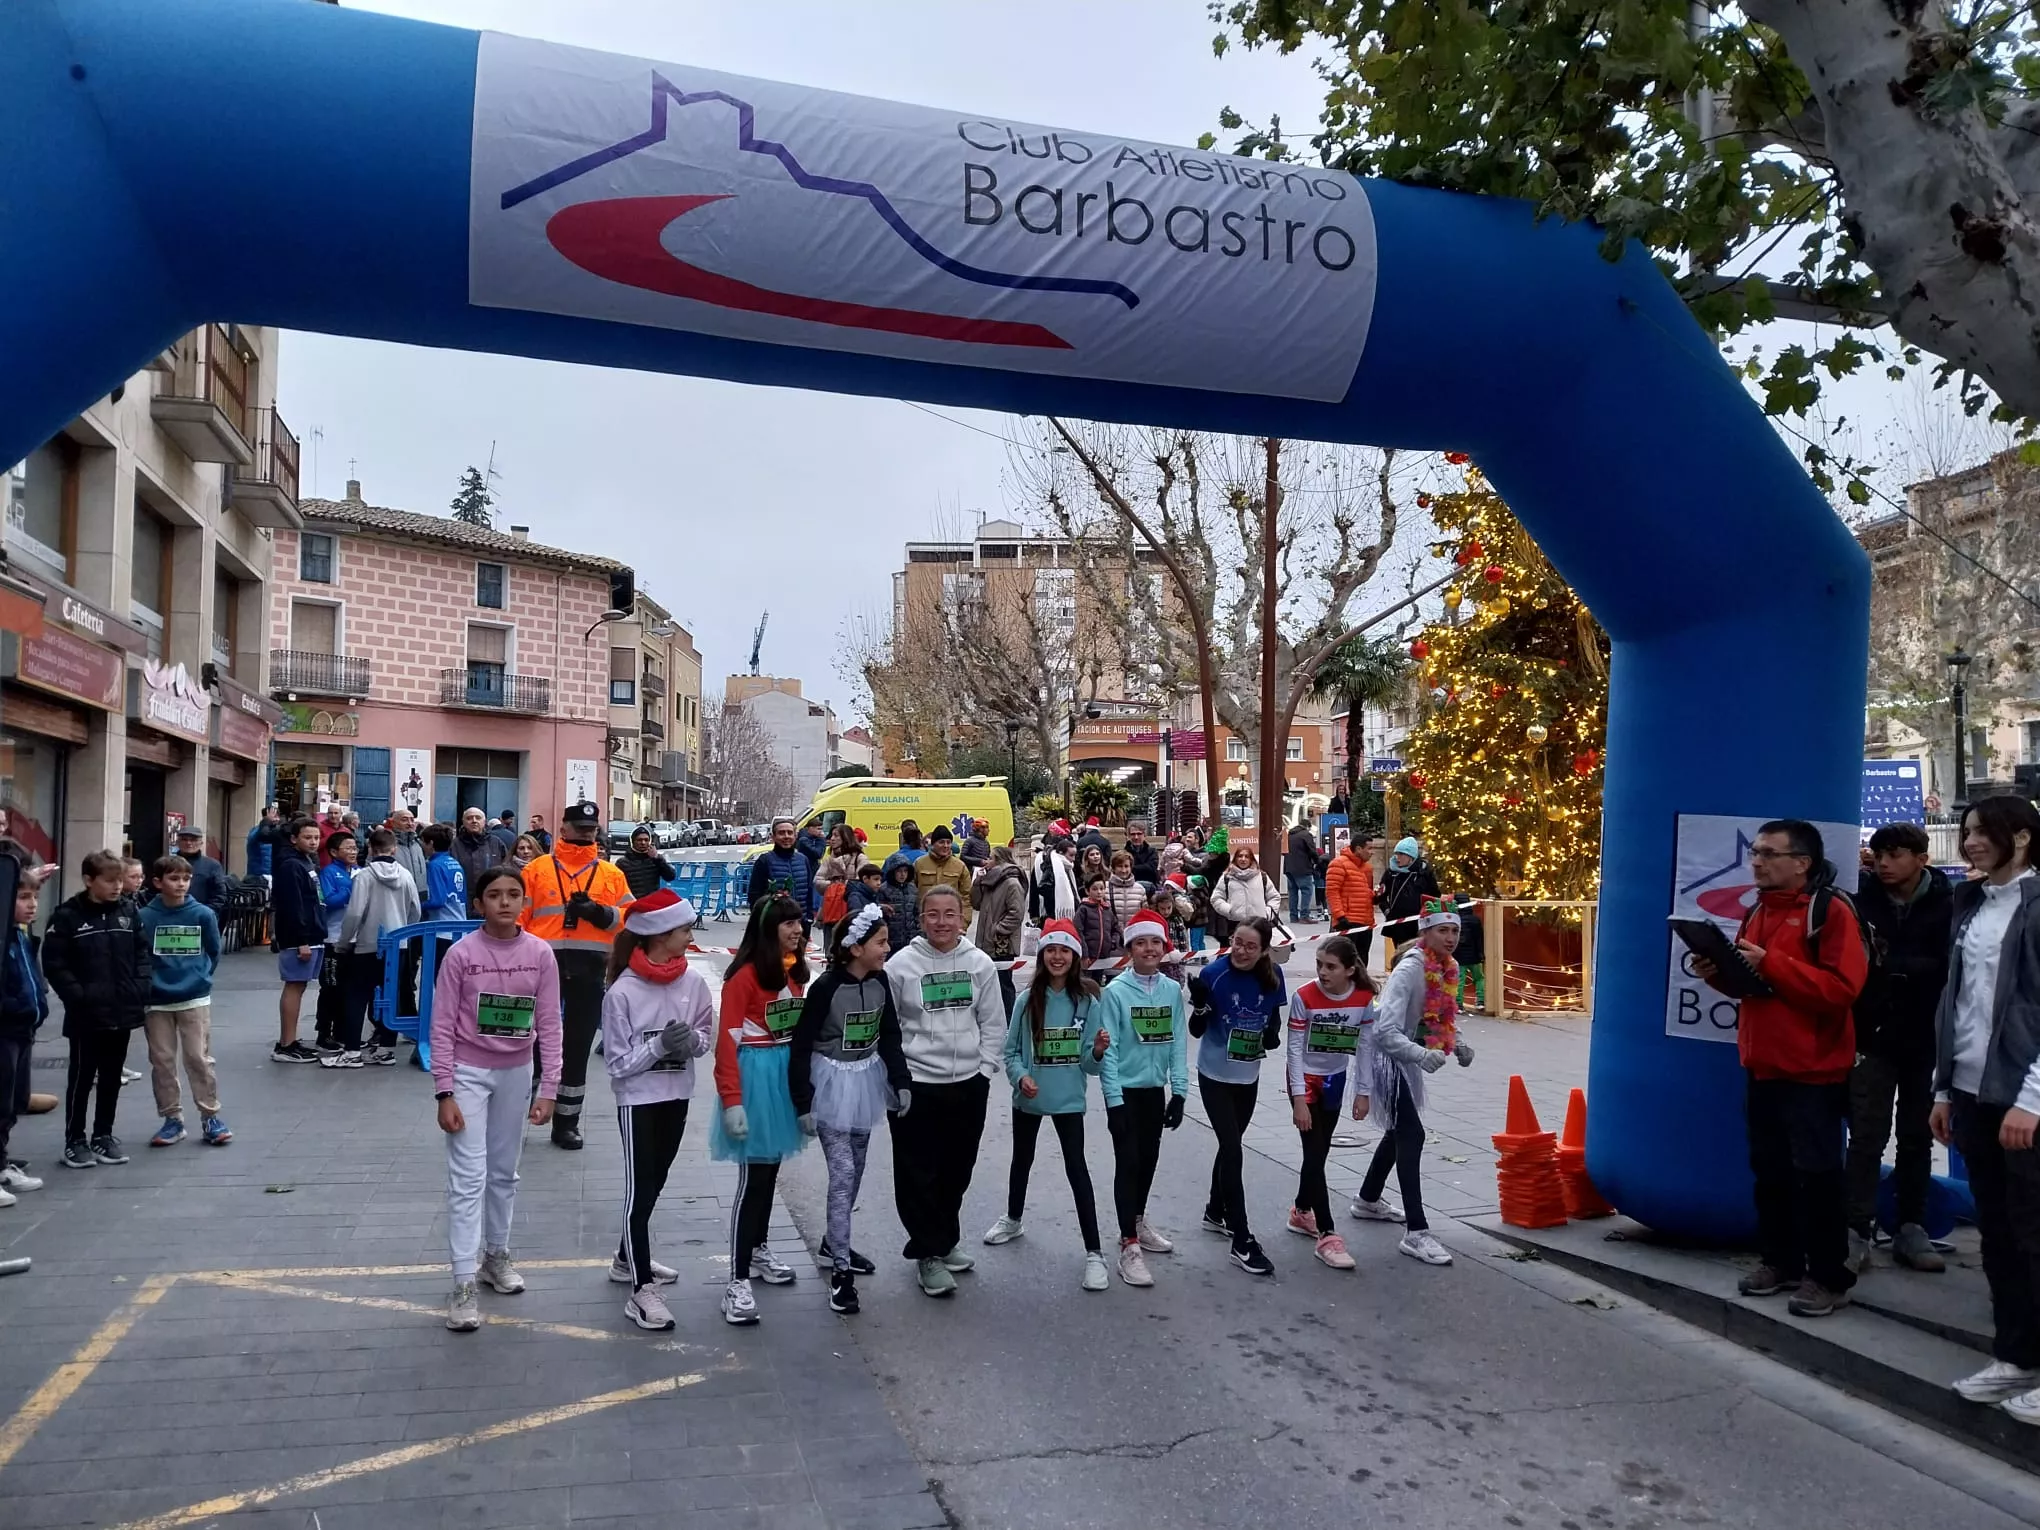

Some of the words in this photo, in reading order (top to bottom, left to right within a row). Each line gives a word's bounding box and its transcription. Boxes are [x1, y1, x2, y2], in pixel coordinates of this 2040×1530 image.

[957, 121, 1093, 165] Club
[1113, 146, 1347, 201] Atletismo
[963, 162, 1357, 272] Barbastro
[1113, 725, 1153, 735] AUTOBUSES
[941, 986, 953, 996] 97
[1145, 1020, 1158, 1028] 90
[1049, 1042, 1061, 1050] 19
